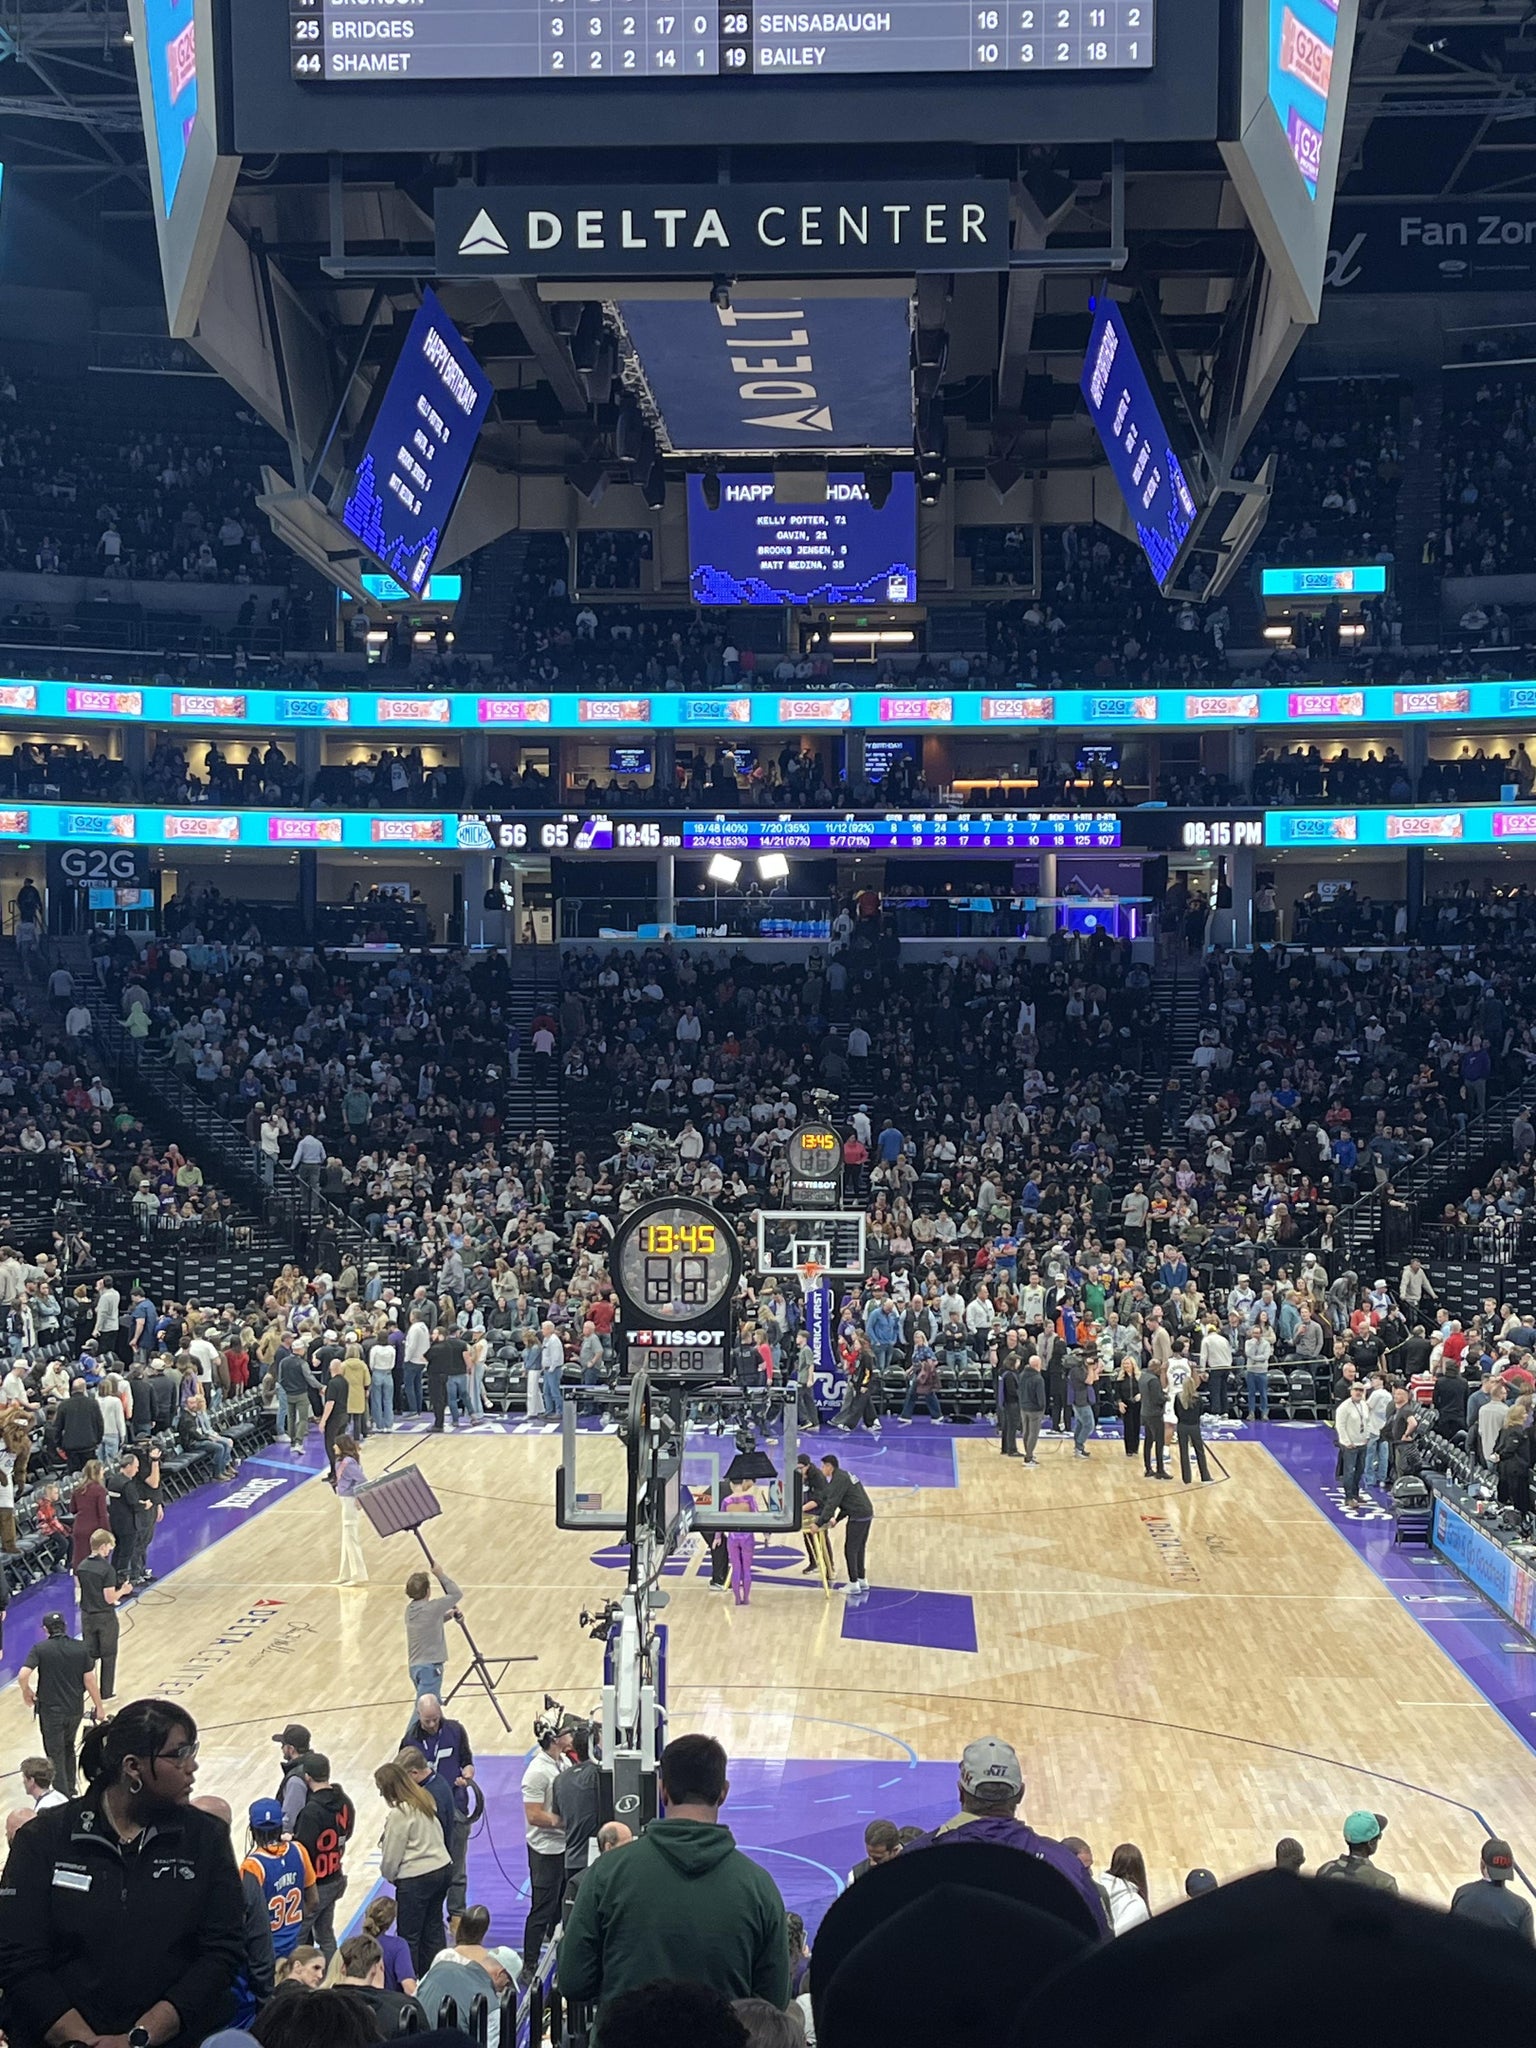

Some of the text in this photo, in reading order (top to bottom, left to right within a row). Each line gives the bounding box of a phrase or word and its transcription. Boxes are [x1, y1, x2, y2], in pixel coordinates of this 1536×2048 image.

[295, 16, 707, 40] 25 BRIDGES 3 3 2 17 0
[724, 8, 1140, 34] 28 SENSABAUGH 16 2 2 11 2
[296, 49, 705, 73] 44 SHAMET 2 2 2 14 1
[725, 42, 1138, 67] 19 BAILEY 10 3 2 18 1
[528, 204, 989, 250] DELTA CENTER
[1400, 217, 1468, 246] Fan
[726, 484, 776, 501] HAPP
[757, 515, 847, 527] KELLY POTTER, 71
[82, 691, 110, 705] G2G
[186, 696, 215, 710] G2G
[1097, 699, 1125, 711] G2G
[1201, 698, 1227, 710] G2G
[1303, 695, 1331, 709] G2G
[1409, 693, 1437, 706] G2G
[290, 701, 318, 712] G2G
[392, 701, 420, 714] G2G
[492, 701, 520, 714] G2G
[593, 701, 620, 714] G2G
[693, 701, 720, 714] G2G
[793, 701, 820, 714] G2G
[894, 700, 922, 713] G2G
[995, 700, 1023, 713] G2G
[74, 815, 103, 829] G2G
[180, 818, 208, 831] G2G
[283, 821, 312, 833] G2G
[385, 822, 414, 834] G2G
[694, 823, 720, 833] 19/48
[722, 823, 748, 834] (40%)
[760, 823, 783, 833] 7/20
[784, 823, 810, 834] (35%)
[934, 823, 947, 832] 24
[959, 823, 969, 832] 14
[984, 823, 991, 833] 7
[1007, 823, 1014, 832] 2
[1031, 823, 1037, 832] 7
[1053, 823, 1065, 832] 19
[1074, 823, 1090, 832] 107
[1098, 823, 1114, 832] 125
[1296, 819, 1325, 832] G2G
[1401, 818, 1430, 830] G2G
[460, 828, 489, 842] KNICKS
[500, 824, 527, 848] 56
[541, 824, 569, 847] 65
[617, 824, 681, 847] 13:45 3RD
[693, 836, 721, 846] 23/43
[829, 836, 845, 846] 5/7
[890, 836, 898, 846] 4
[934, 836, 947, 846] 23
[958, 836, 969, 845] 17
[983, 836, 991, 846] 6
[1007, 836, 1014, 846] 3
[1028, 836, 1040, 845] 10
[1053, 836, 1065, 845] 18
[1074, 836, 1091, 845] 125
[1098, 836, 1115, 845] 107
[1183, 822, 1262, 846] 08:15 PM
[61, 848, 135, 878] G2G
[802, 1134, 834, 1150] 13:45
[648, 1225, 715, 1254] 13:45
[813, 1292, 822, 1365] AMERICA FIRST
[653, 1330, 725, 1345] TISSOT
[209, 1610, 278, 1646] DELTA
[148, 1650, 231, 1695] CENTER
[268, 1887, 303, 1932] 32
